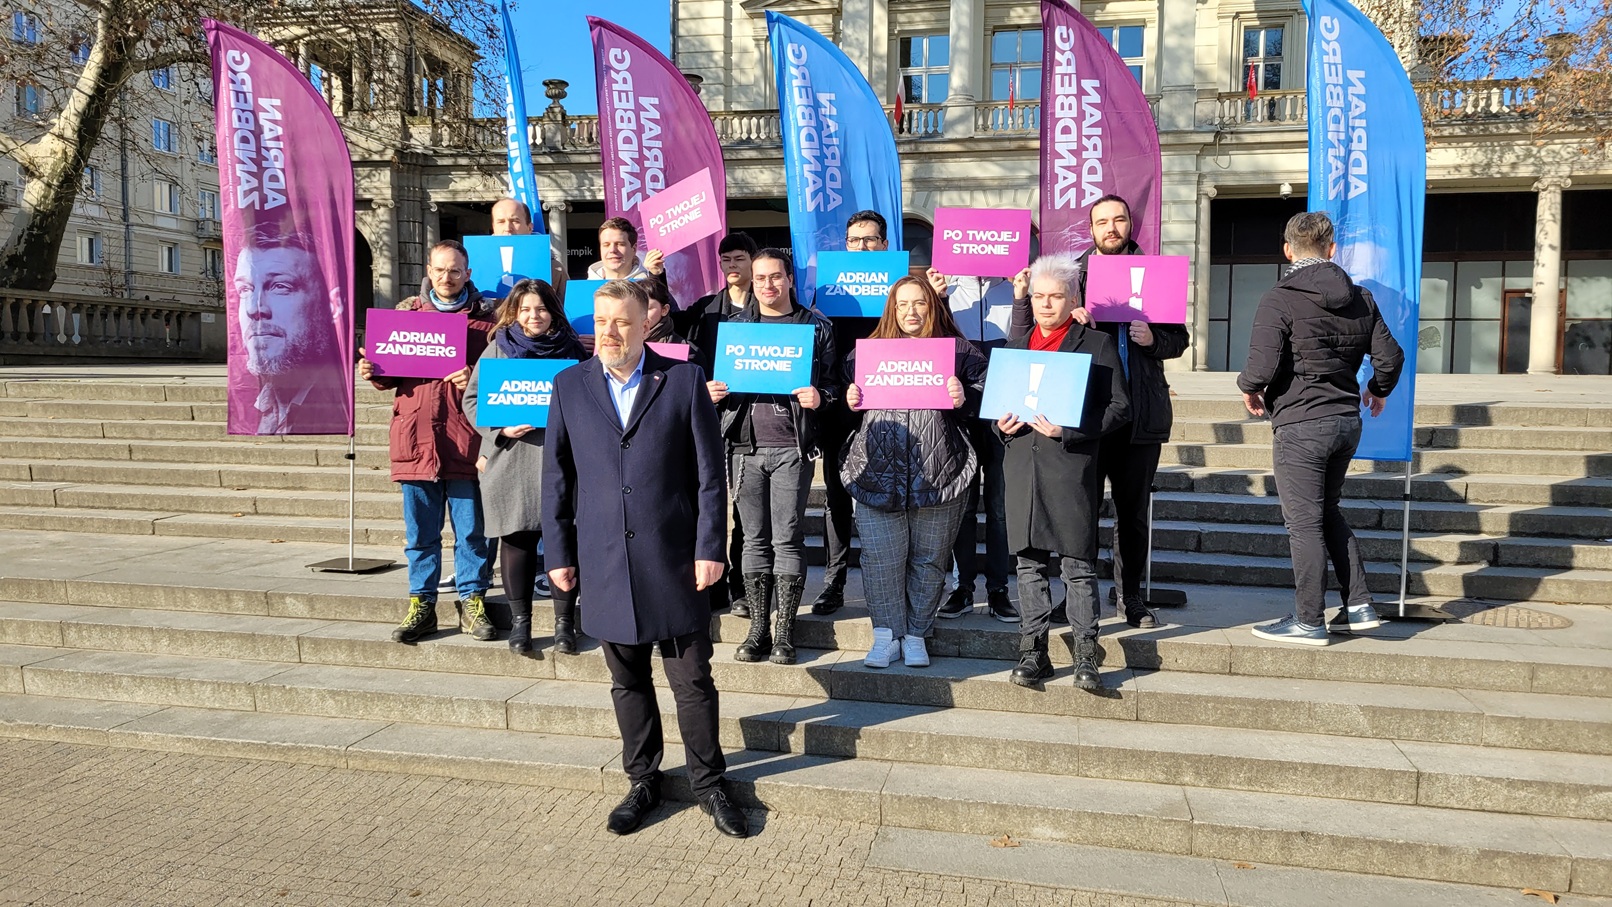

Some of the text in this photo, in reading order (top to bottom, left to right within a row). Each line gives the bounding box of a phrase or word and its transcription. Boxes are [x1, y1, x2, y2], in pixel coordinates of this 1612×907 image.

[649, 191, 706, 229] PO TWOJEJ
[659, 207, 702, 236] STRONIE
[943, 230, 1020, 242] PO TWOJEJ
[567, 246, 593, 257] empik
[952, 243, 1009, 255] STRONIE
[836, 272, 888, 283] ADRIAN
[388, 330, 445, 344] ADRIAN
[375, 343, 456, 357] ZANDBERG
[726, 345, 802, 358] PO TWOJEJ
[734, 359, 791, 371] STRONIE
[876, 361, 933, 373] ADRIAN
[865, 374, 944, 386] ZANDBERG
